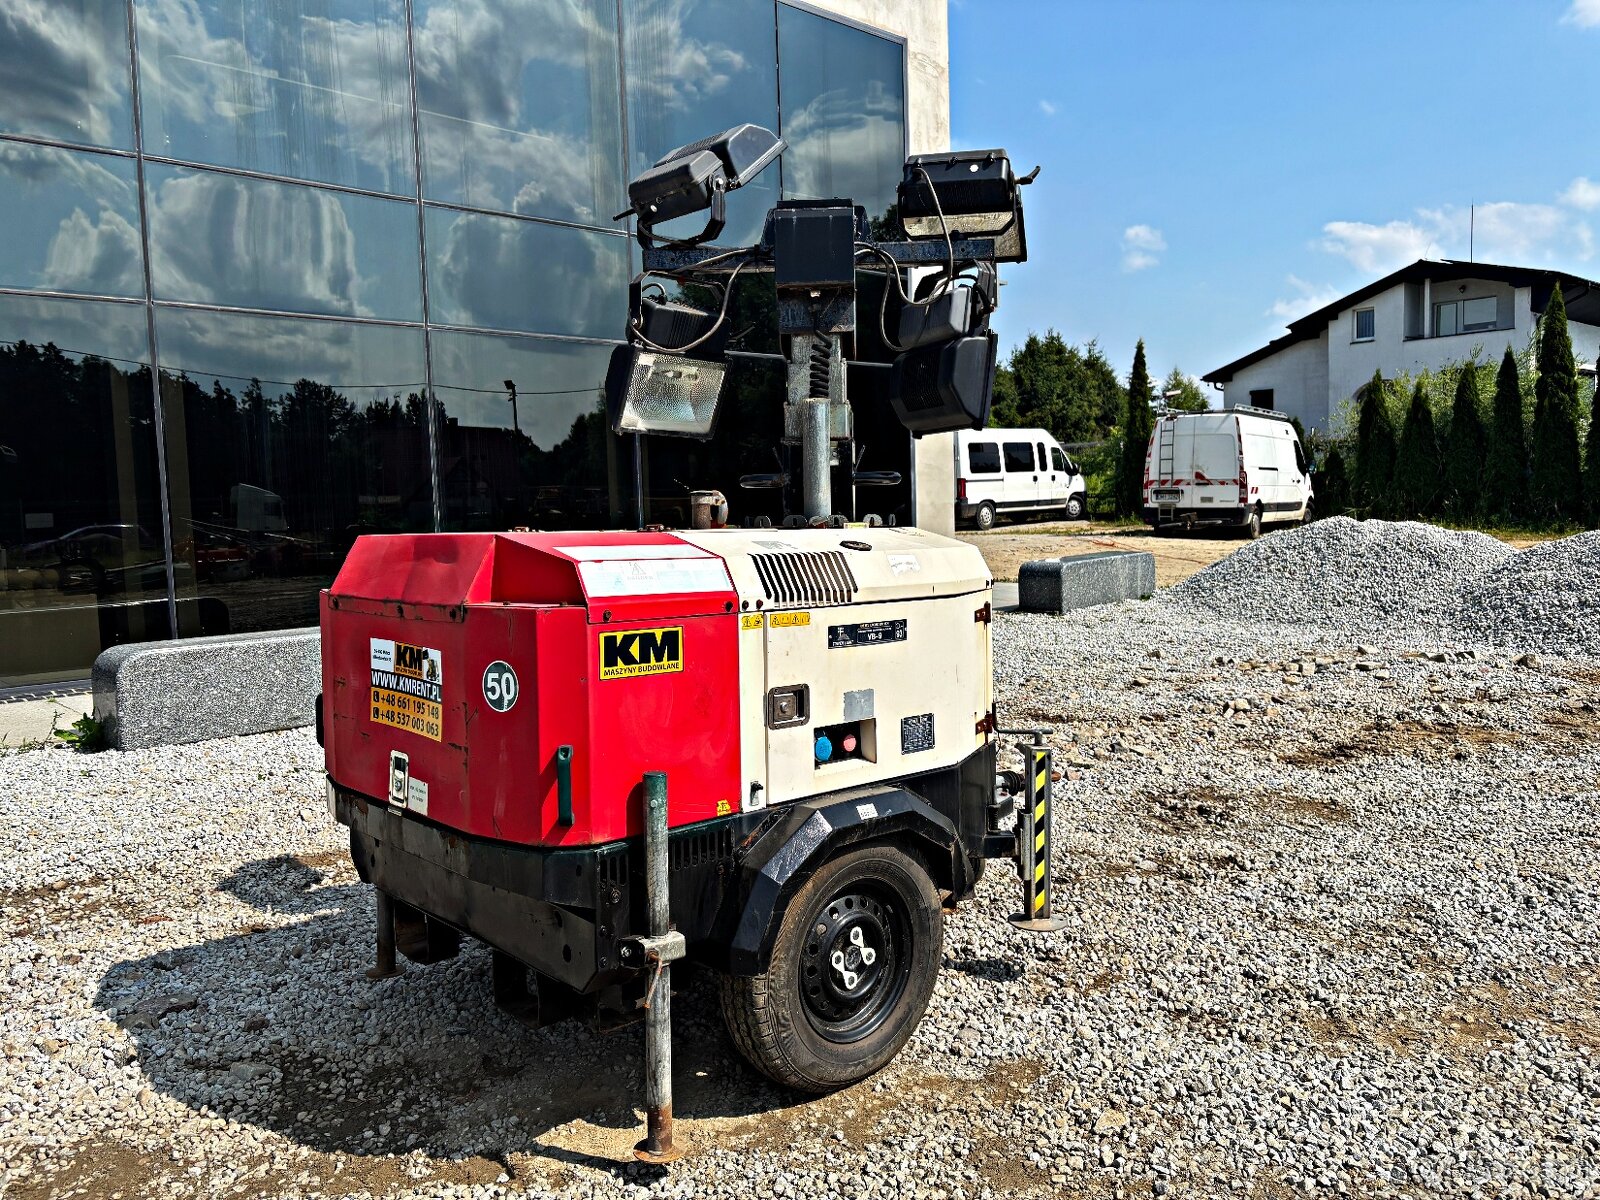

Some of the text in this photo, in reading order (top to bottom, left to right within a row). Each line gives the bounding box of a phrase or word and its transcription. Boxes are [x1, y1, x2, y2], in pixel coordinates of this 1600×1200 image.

[396, 644, 423, 672] KM
[604, 630, 680, 668] KM
[604, 662, 679, 676] MASZYNY BUDOWLANE
[371, 671, 442, 702] WWW.KMRENT.PL
[487, 672, 515, 700] 50
[380, 693, 439, 719] +48 661 195 148
[380, 710, 439, 737] +48 537 003 063
